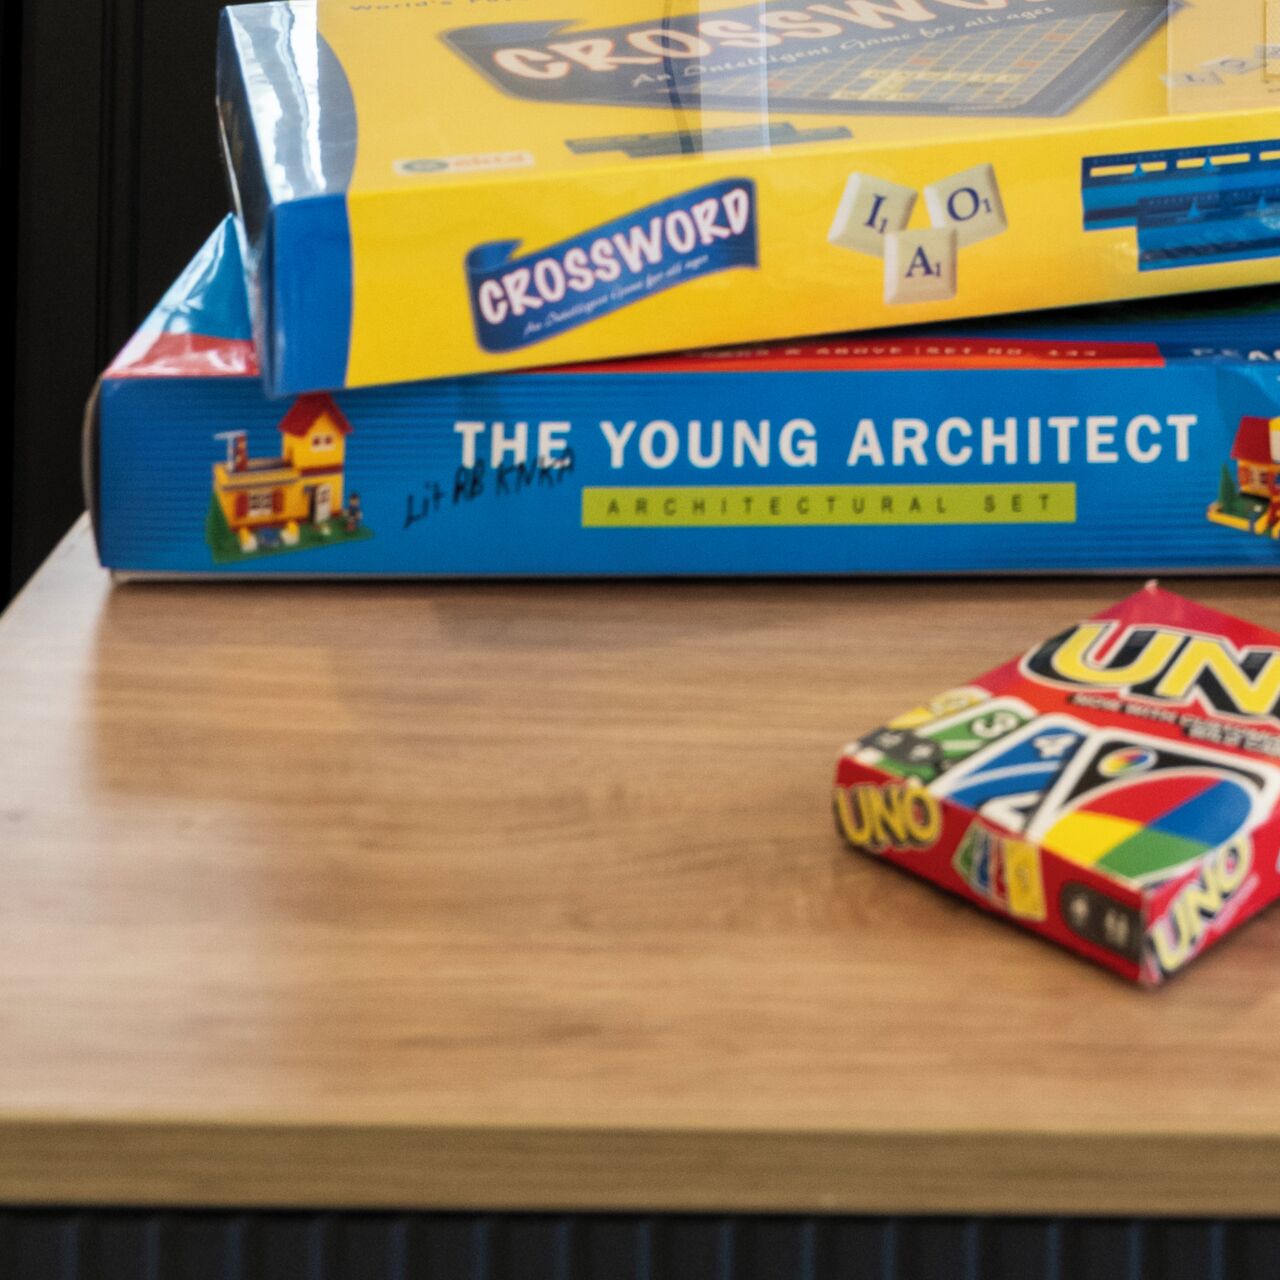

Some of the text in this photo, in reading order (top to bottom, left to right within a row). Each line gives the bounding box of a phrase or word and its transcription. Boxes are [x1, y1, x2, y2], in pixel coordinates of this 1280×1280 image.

[919, 21, 956, 40] for
[960, 13, 996, 31] all
[1005, 5, 1055, 24] ages
[477, 187, 750, 325] CROSSWORD
[453, 414, 1198, 469] THE YOUNG ARCHITECT
[605, 493, 1053, 517] ARCHITECTURAL SET
[833, 782, 942, 854] UNO
[1149, 833, 1253, 975] UNO
